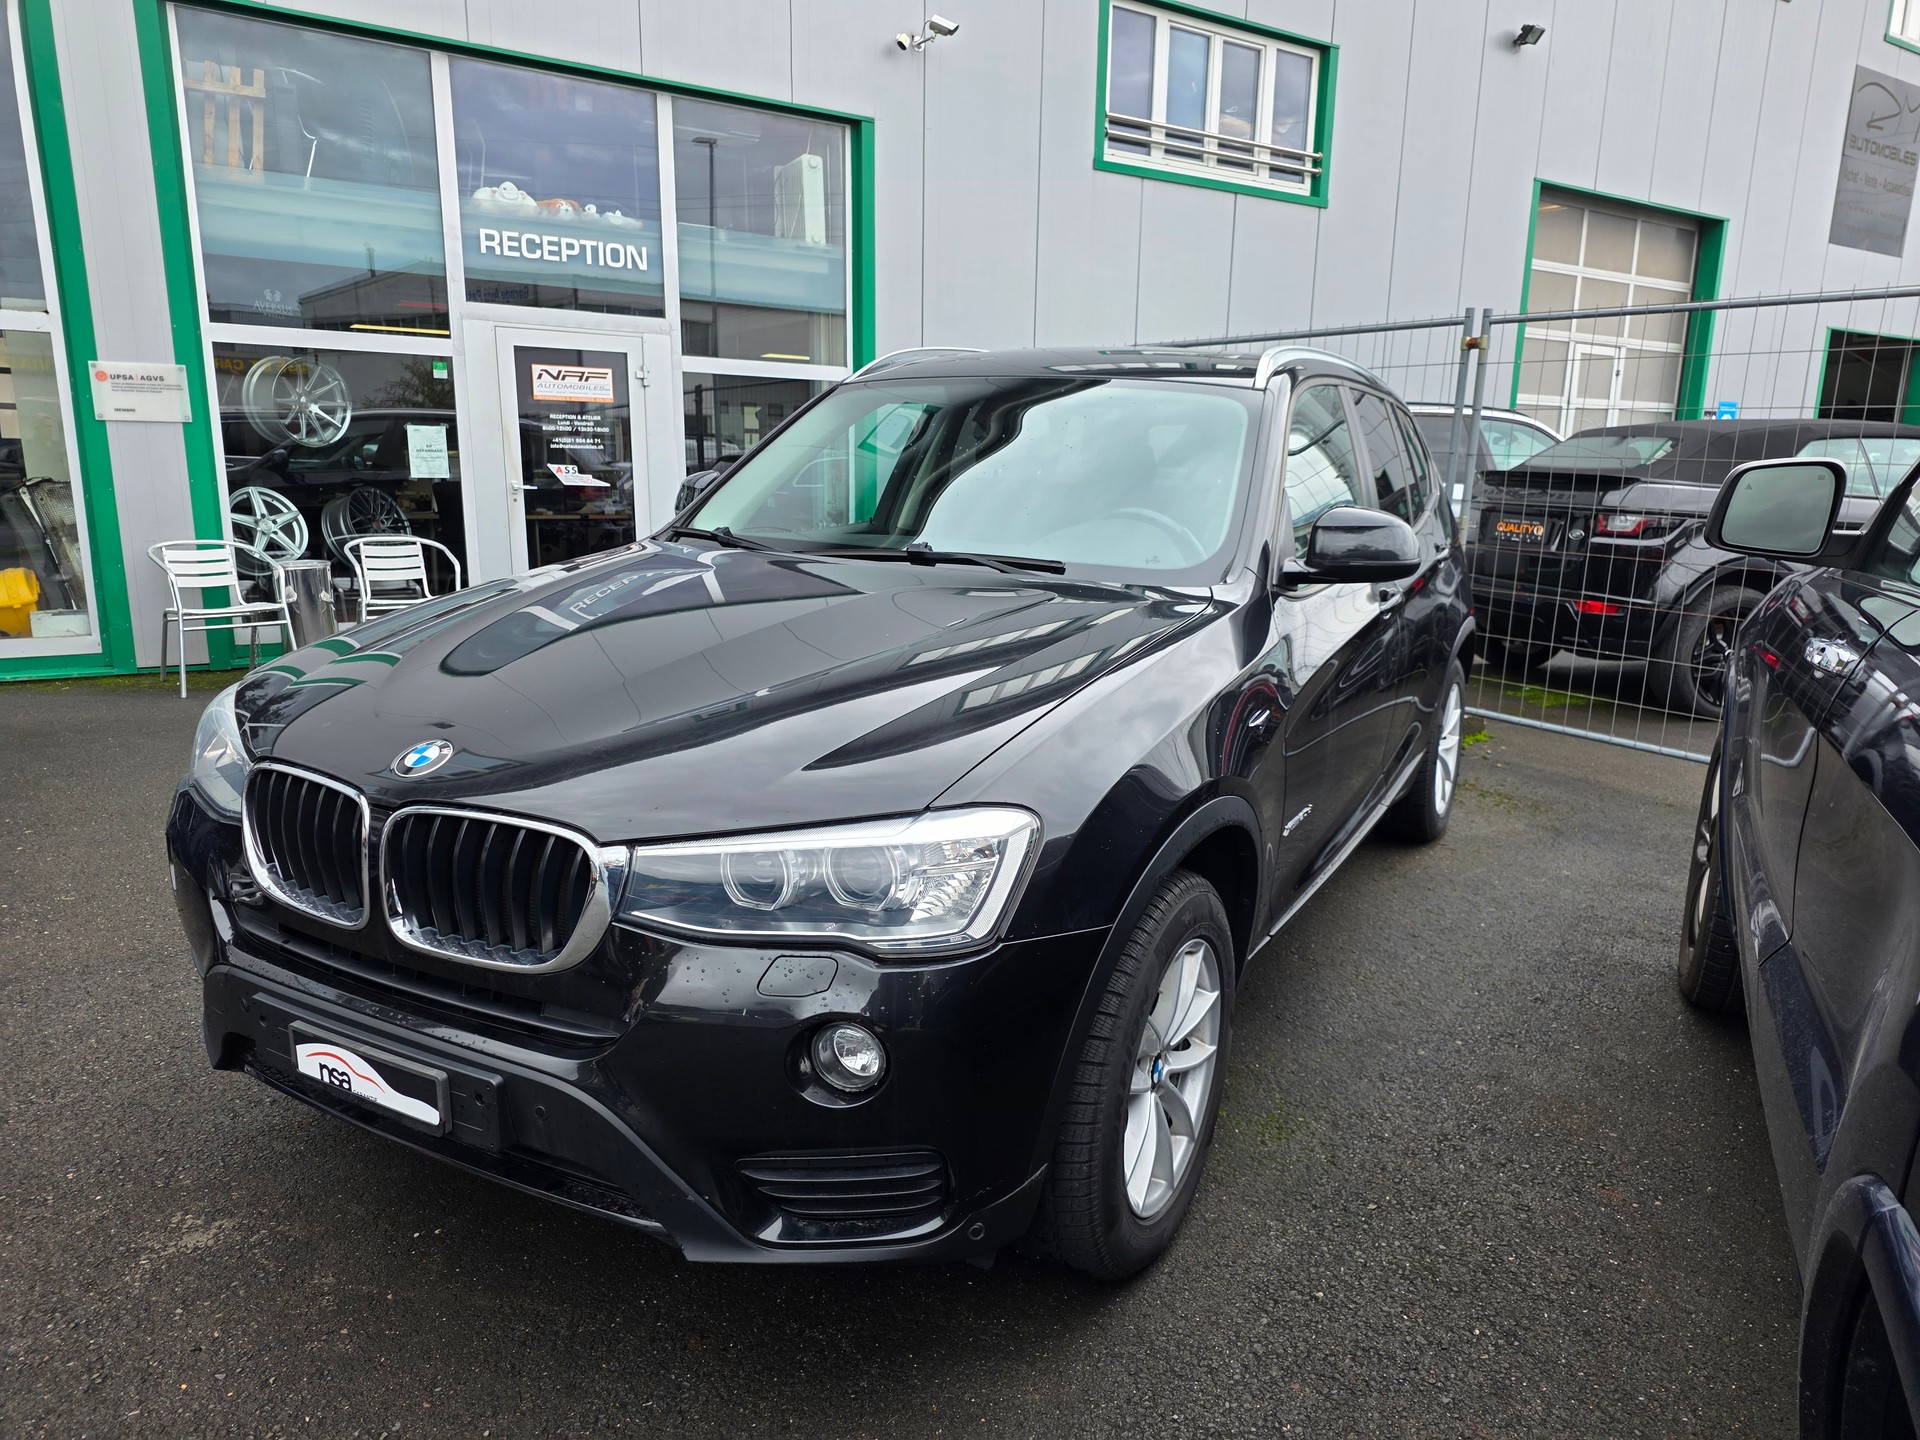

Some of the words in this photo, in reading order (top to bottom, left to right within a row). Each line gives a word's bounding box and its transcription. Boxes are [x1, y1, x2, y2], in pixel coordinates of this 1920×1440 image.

[479, 228, 648, 271] RECEPTION
[253, 300, 294, 316] AVERSUS
[109, 373, 134, 381] UPSA
[537, 369, 609, 382] NAF
[537, 383, 605, 391] AUTOMOBILES
[319, 1062, 352, 1092] nsa
